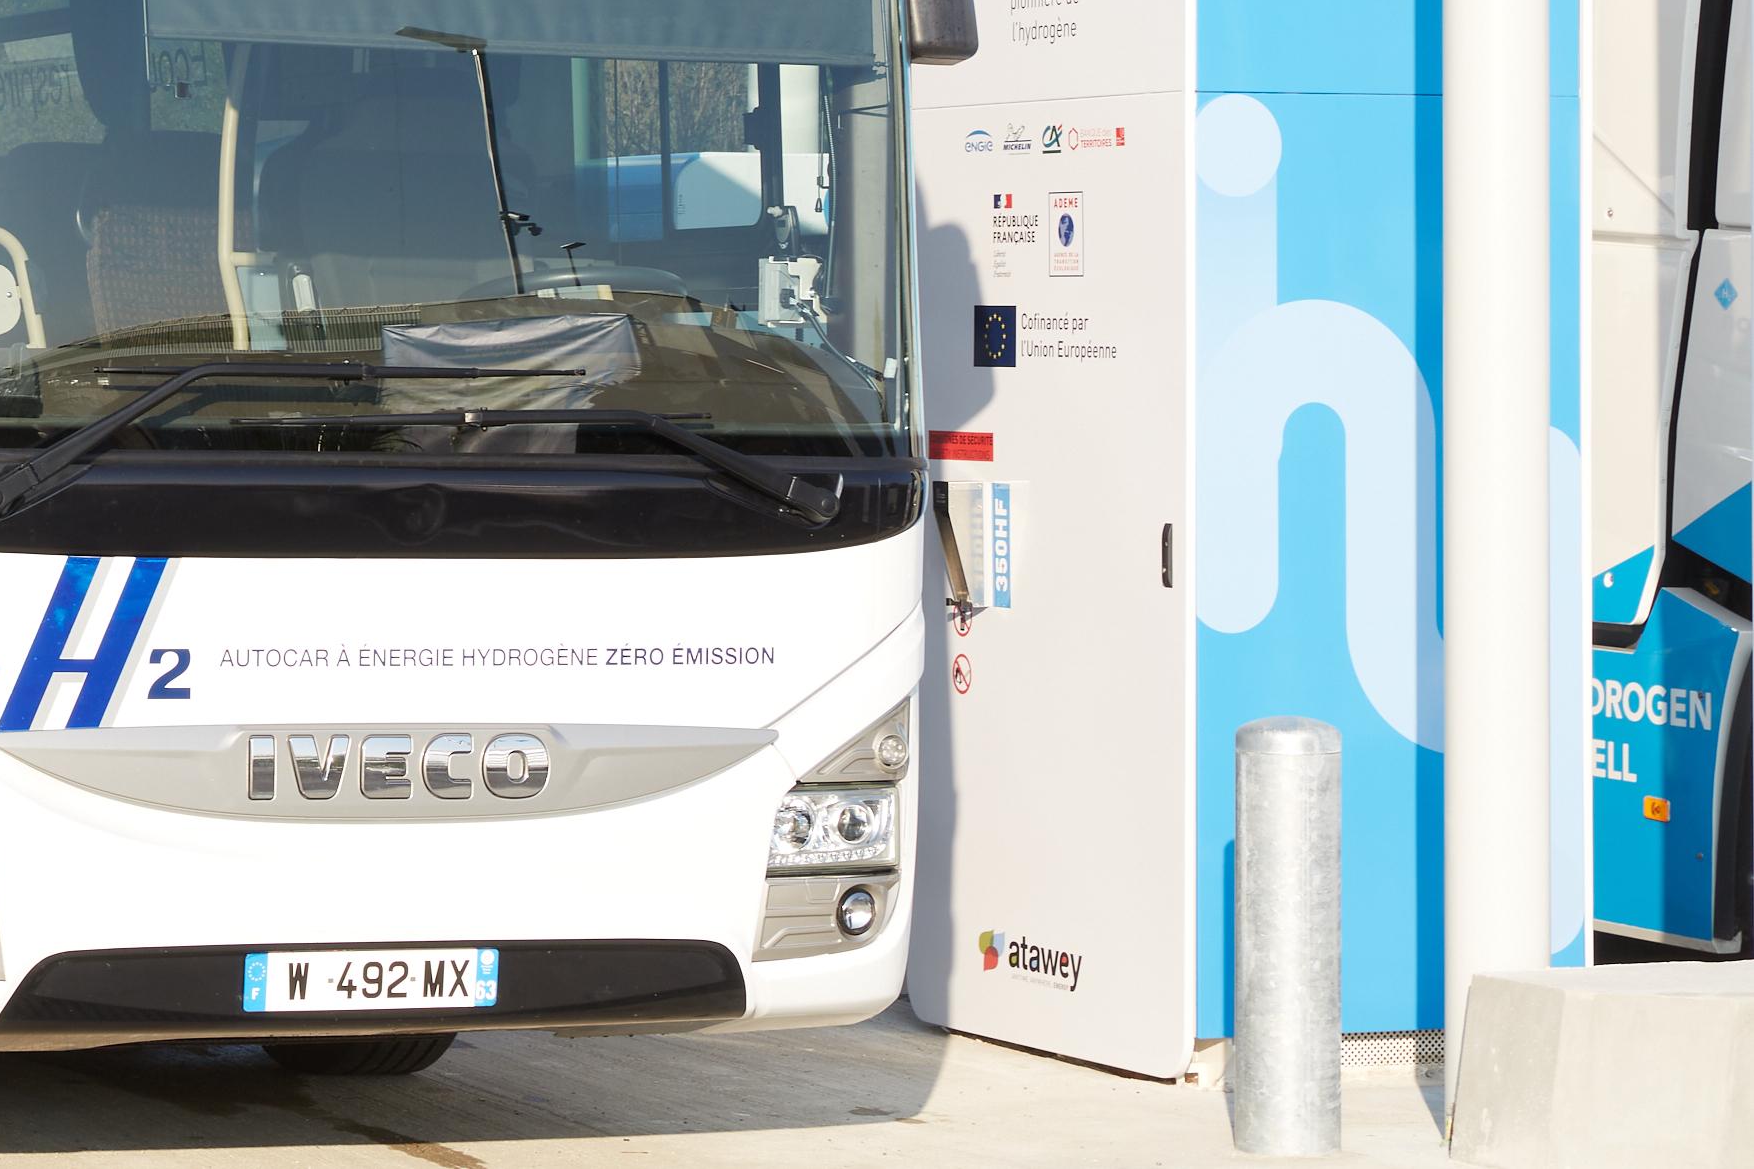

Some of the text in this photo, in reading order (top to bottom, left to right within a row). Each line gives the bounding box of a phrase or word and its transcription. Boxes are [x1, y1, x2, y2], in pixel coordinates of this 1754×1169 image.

[1012, 17, 1077, 46] l'hydrogène
[1003, 142, 1032, 151] MICHELIN
[1080, 138, 1112, 149] TERRITOIRES
[1053, 197, 1078, 208] ADEME
[993, 213, 1038, 229] RÉPUBLIQUE
[993, 231, 1035, 245] FRANÇAISE
[1021, 312, 1088, 334] Cofinancé par
[1021, 340, 1117, 362] l'Union Européenne
[995, 498, 1008, 592] 350HF
[219, 641, 776, 668] AUTOCAR À ÉNERGIE HYDROGÈNE ZÉRO ÉMISSION
[248, 732, 550, 801] IVECO
[1008, 935, 1082, 992] atawey
[251, 988, 260, 1000] F
[475, 979, 497, 1001] 63
